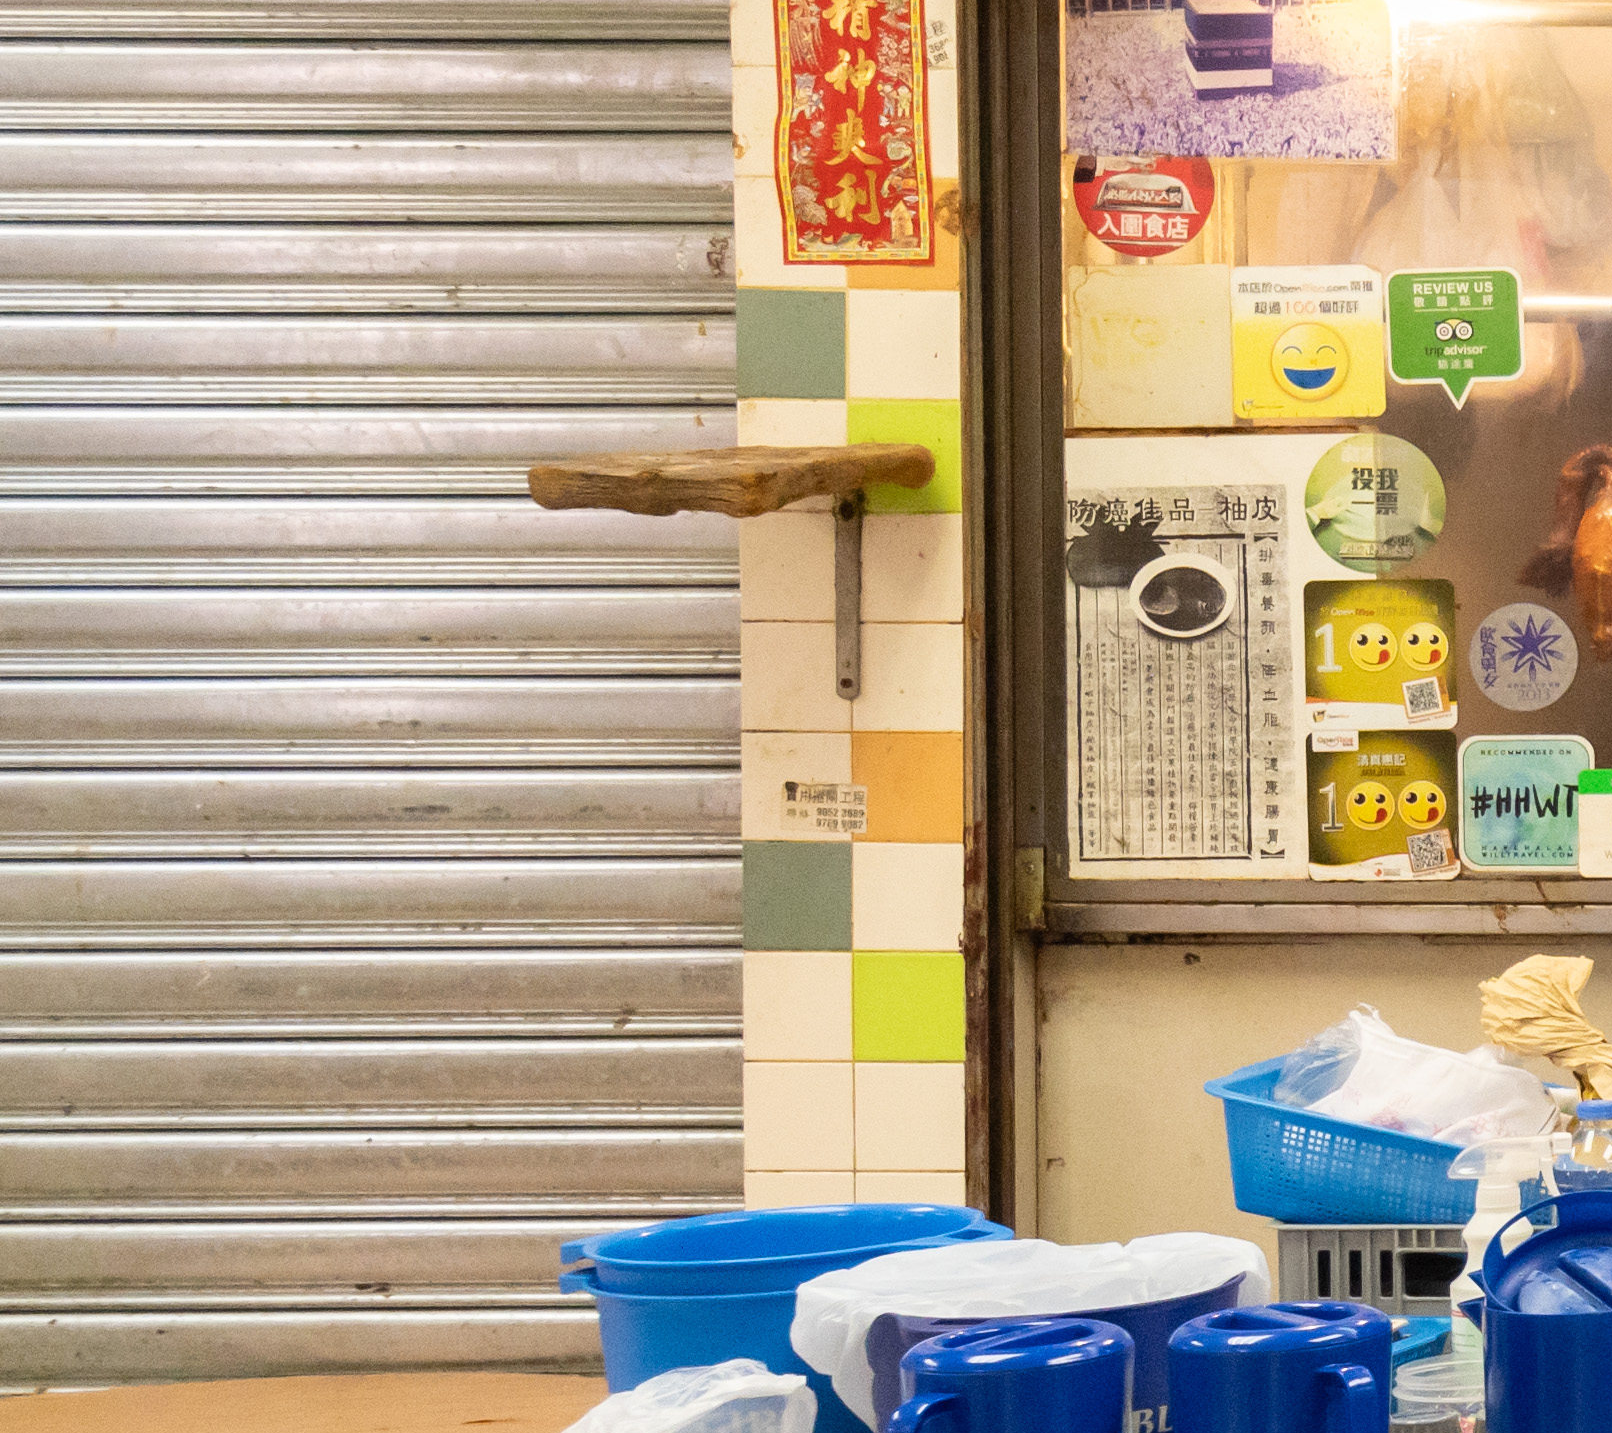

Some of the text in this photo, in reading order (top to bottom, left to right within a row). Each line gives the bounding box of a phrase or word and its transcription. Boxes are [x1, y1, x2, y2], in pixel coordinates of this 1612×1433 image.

[1413, 280, 1494, 295] REVIEW US
[1425, 344, 1484, 356] tripadvisor
